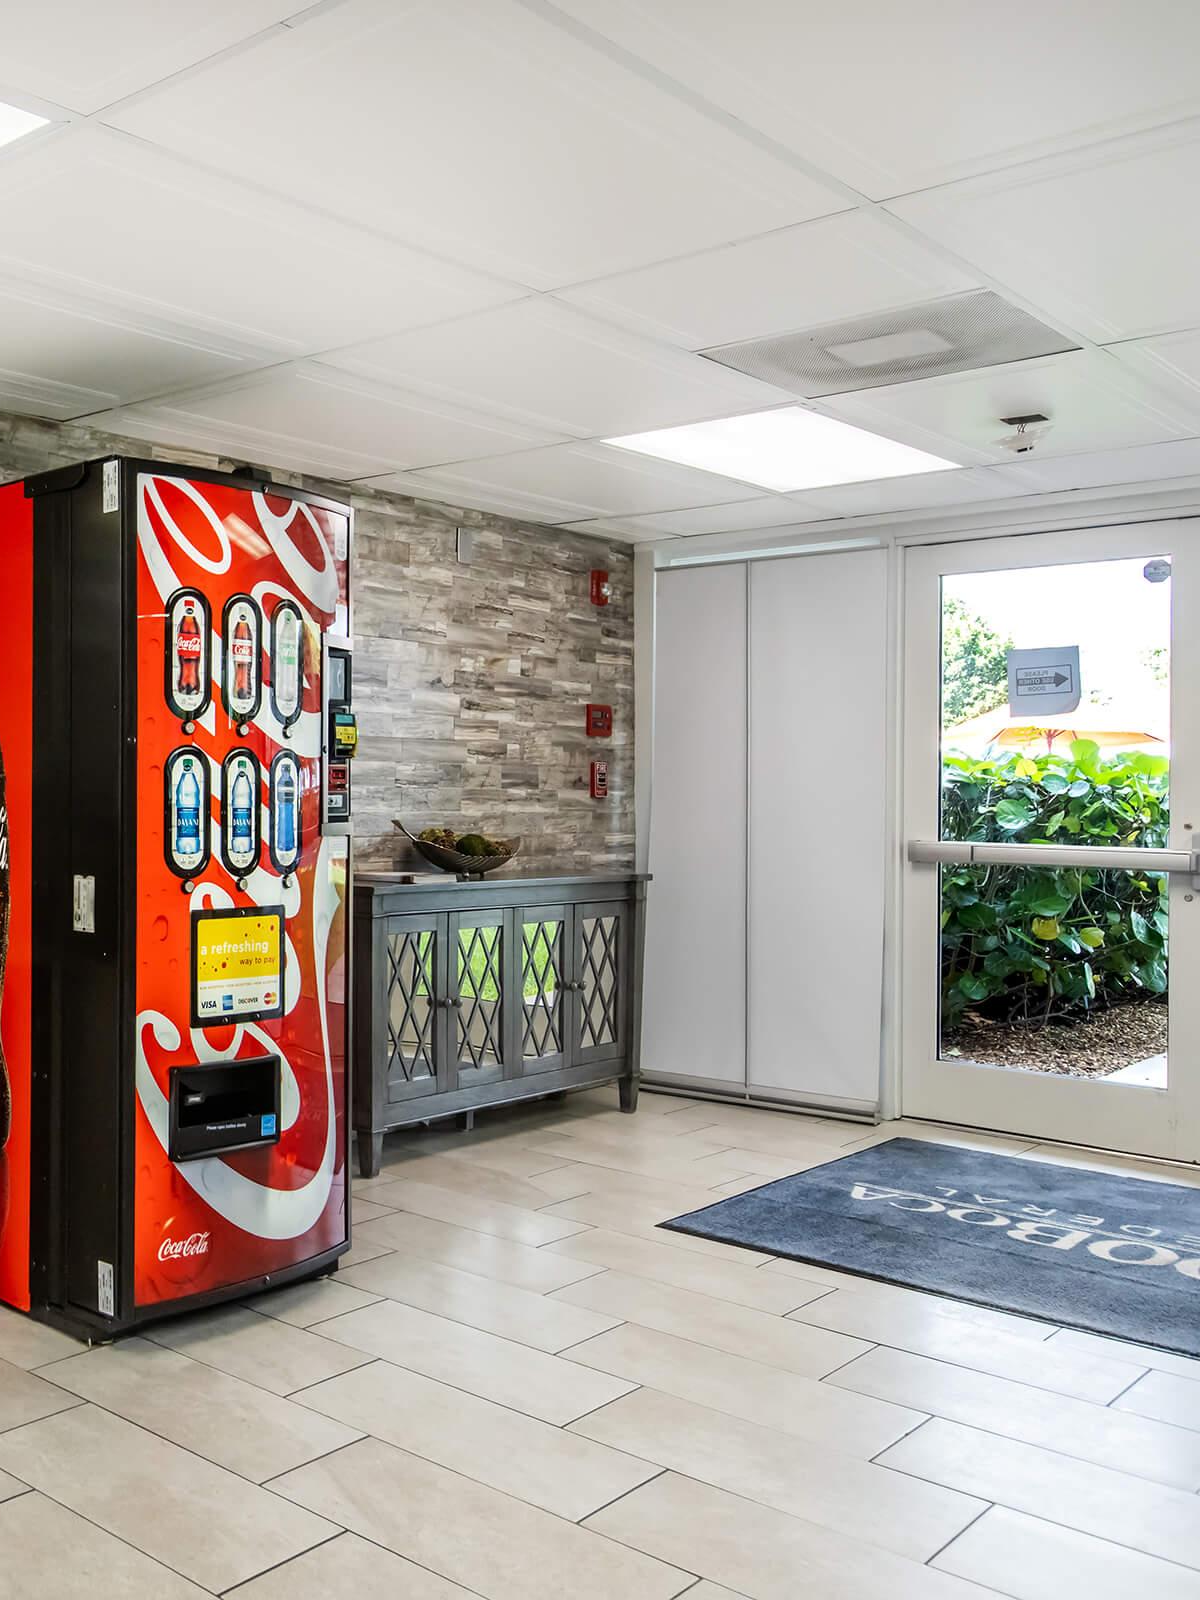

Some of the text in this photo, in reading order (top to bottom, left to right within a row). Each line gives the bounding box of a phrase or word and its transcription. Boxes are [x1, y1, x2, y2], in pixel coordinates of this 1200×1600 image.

[201, 940, 269, 955] a refreshing
[240, 958, 253, 966] way
[201, 1000, 217, 1009] VISA
[158, 1232, 209, 1261] Coca-Cola
